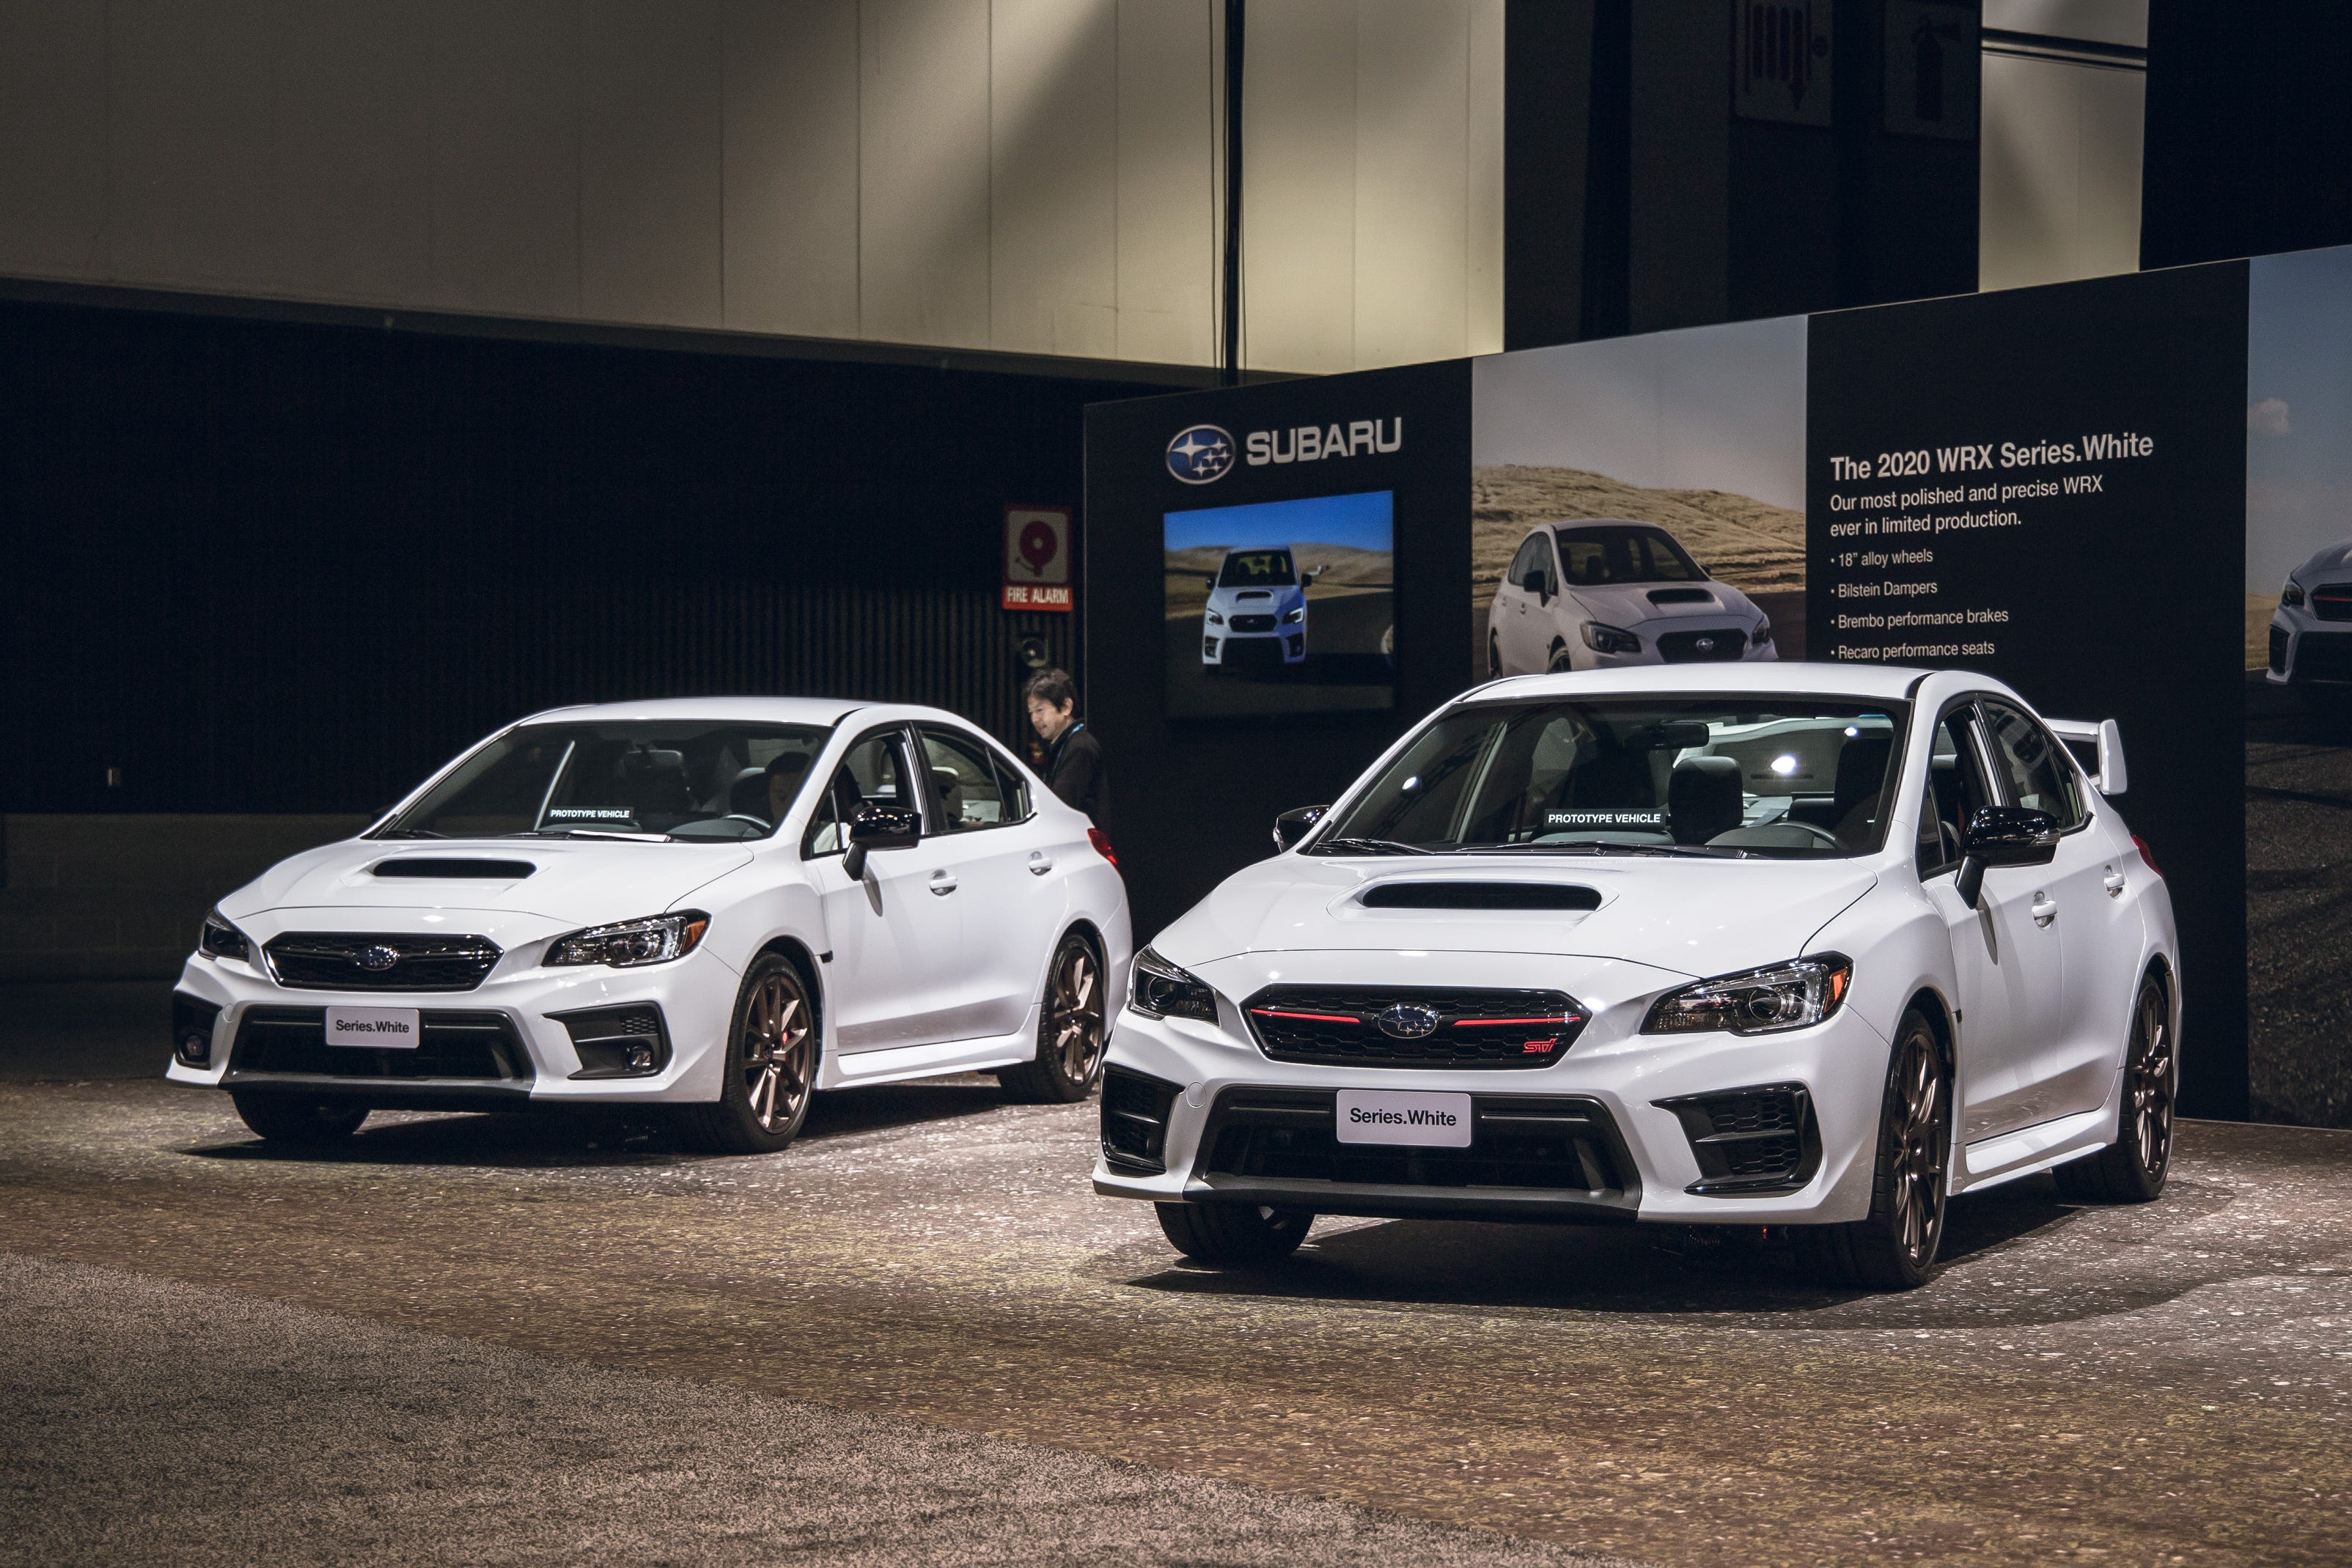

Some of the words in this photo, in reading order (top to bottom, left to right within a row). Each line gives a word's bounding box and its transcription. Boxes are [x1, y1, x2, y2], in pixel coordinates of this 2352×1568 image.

[1247, 417, 1402, 465] SUBARU
[1830, 456, 1871, 481] The
[1878, 450, 1930, 477] 2020
[1936, 443, 1993, 473] WRX
[2000, 433, 2154, 468] Series.White
[1830, 494, 1857, 511] Our
[1861, 491, 1897, 509] most
[1901, 485, 1964, 510] polished
[1969, 482, 1996, 501] and
[2002, 479, 2059, 504] precise
[2063, 474, 2103, 494] WRX
[1830, 523, 1861, 537] ever
[1865, 518, 1877, 534] in
[1882, 515, 1930, 534] limited
[1935, 509, 2021, 534] production.
[1861, 551, 1888, 568] alloy
[1892, 548, 1933, 564] wheels
[1006, 586, 1028, 602] FIRE
[1032, 587, 1069, 604] ALARM
[1838, 582, 1880, 597] Bilstein
[1884, 581, 1938, 597] Dampers
[1838, 614, 1884, 629] Brembo
[1888, 611, 1963, 630] performance
[1967, 608, 2009, 623] brakes
[1838, 645, 1879, 660] Recaro
[1883, 643, 1958, 661] performance
[1962, 641, 1995, 655] seats
[551, 809, 596, 817] PROTOTYPE
[598, 810, 630, 818] VEHICLE
[1548, 814, 1612, 823] PROTOTYPE
[1615, 814, 1661, 823] VEHICLE
[336, 1020, 410, 1033] Series.White
[1350, 1107, 1457, 1127] Series.White
